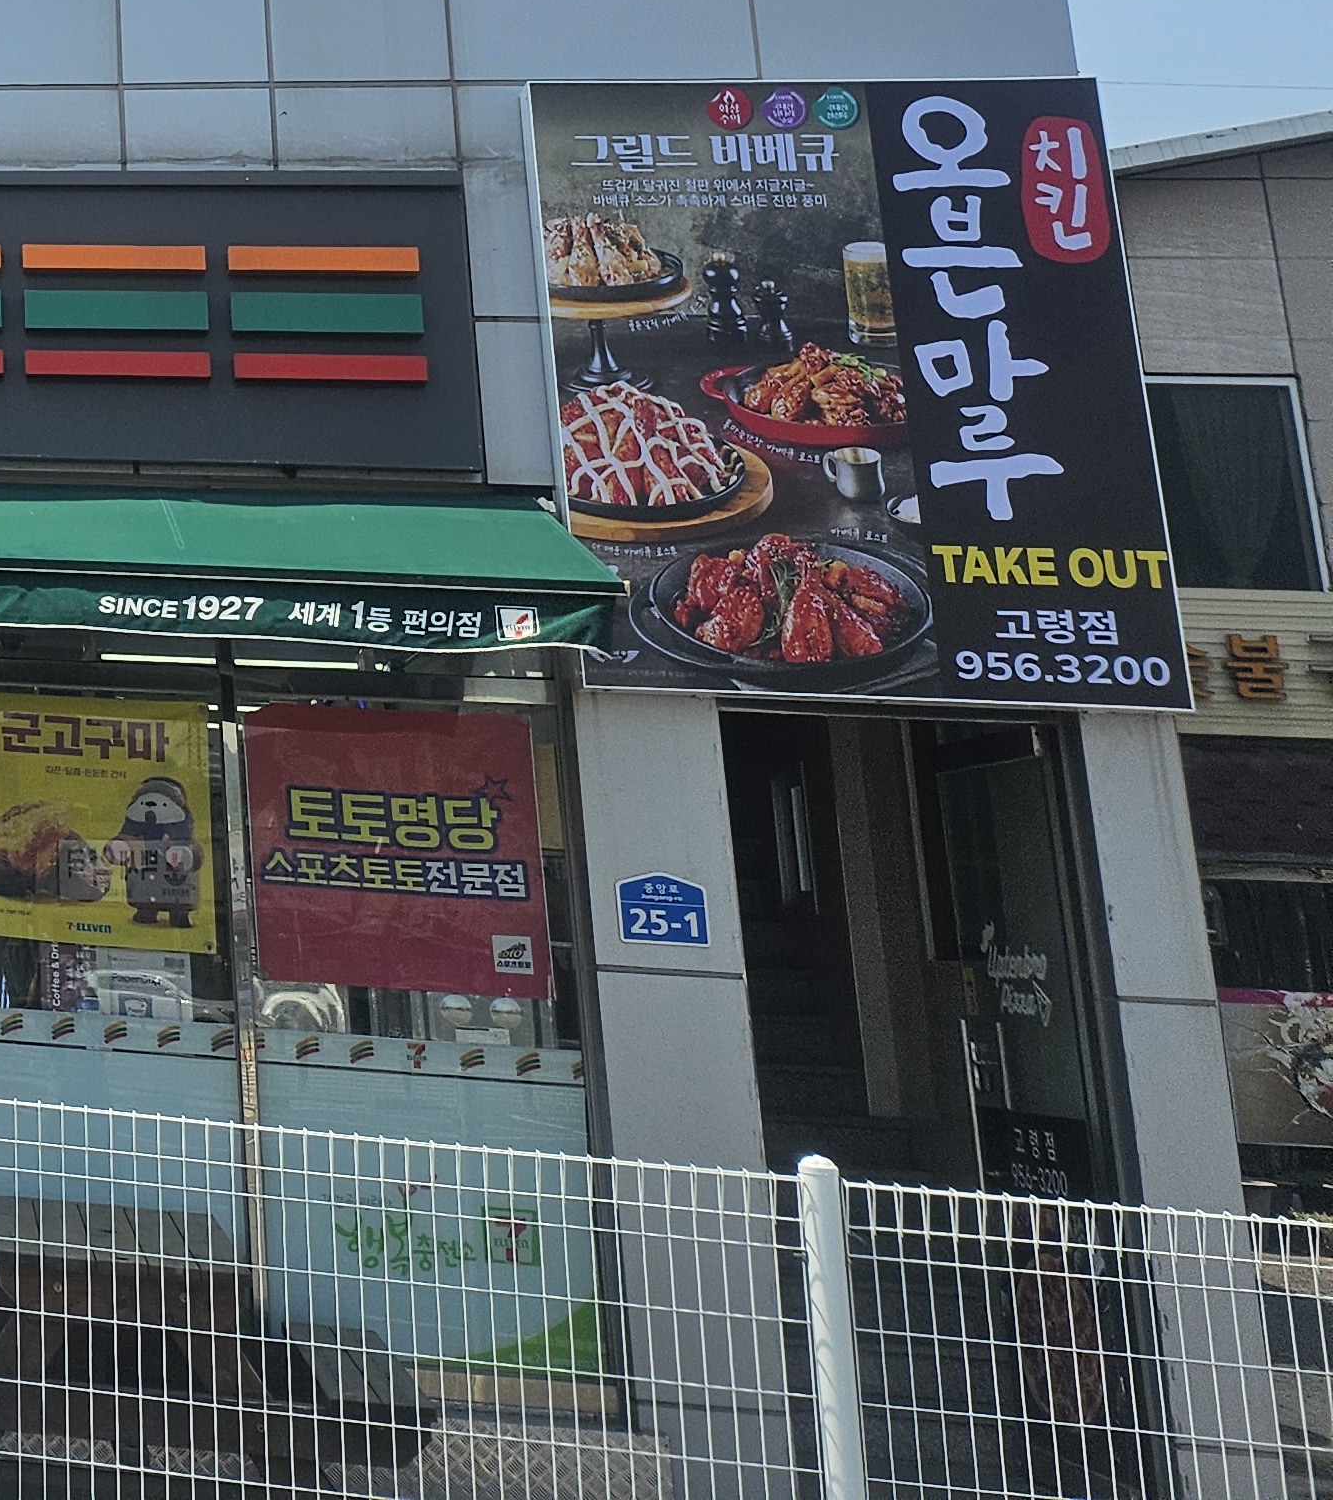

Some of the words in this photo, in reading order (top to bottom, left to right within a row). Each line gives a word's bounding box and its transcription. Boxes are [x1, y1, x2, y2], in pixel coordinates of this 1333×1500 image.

[571, 134, 698, 173] 그릴드
[709, 133, 839, 172] 바베큐
[593, 194, 630, 207] 바베큐
[634, 194, 672, 207] 소스가
[730, 194, 767, 208] 스며든
[772, 194, 798, 208] 진한
[802, 194, 828, 208] 풍미
[602, 179, 640, 192] 뜨겁게
[713, 179, 752, 192] 위에서
[1029, 126, 1094, 252] 치킨
[891, 95, 1064, 521] 오븐마루
[931, 545, 1059, 588] TAKE
[1068, 548, 1168, 589] OUT
[288, 601, 341, 628] 세계
[349, 601, 393, 633] 1등
[401, 609, 483, 638] 편의점
[995, 608, 1117, 646] 고령점
[956, 650, 1171, 687] 956.3200
[1, 710, 170, 763] 군고구마
[288, 788, 499, 852] 토토명당
[263, 850, 529, 899] 스포츠토토전문점
[643, 882, 680, 894] 중앙로
[629, 907, 699, 938] 25-1
[1011, 1162, 1068, 1197] 956-3200
